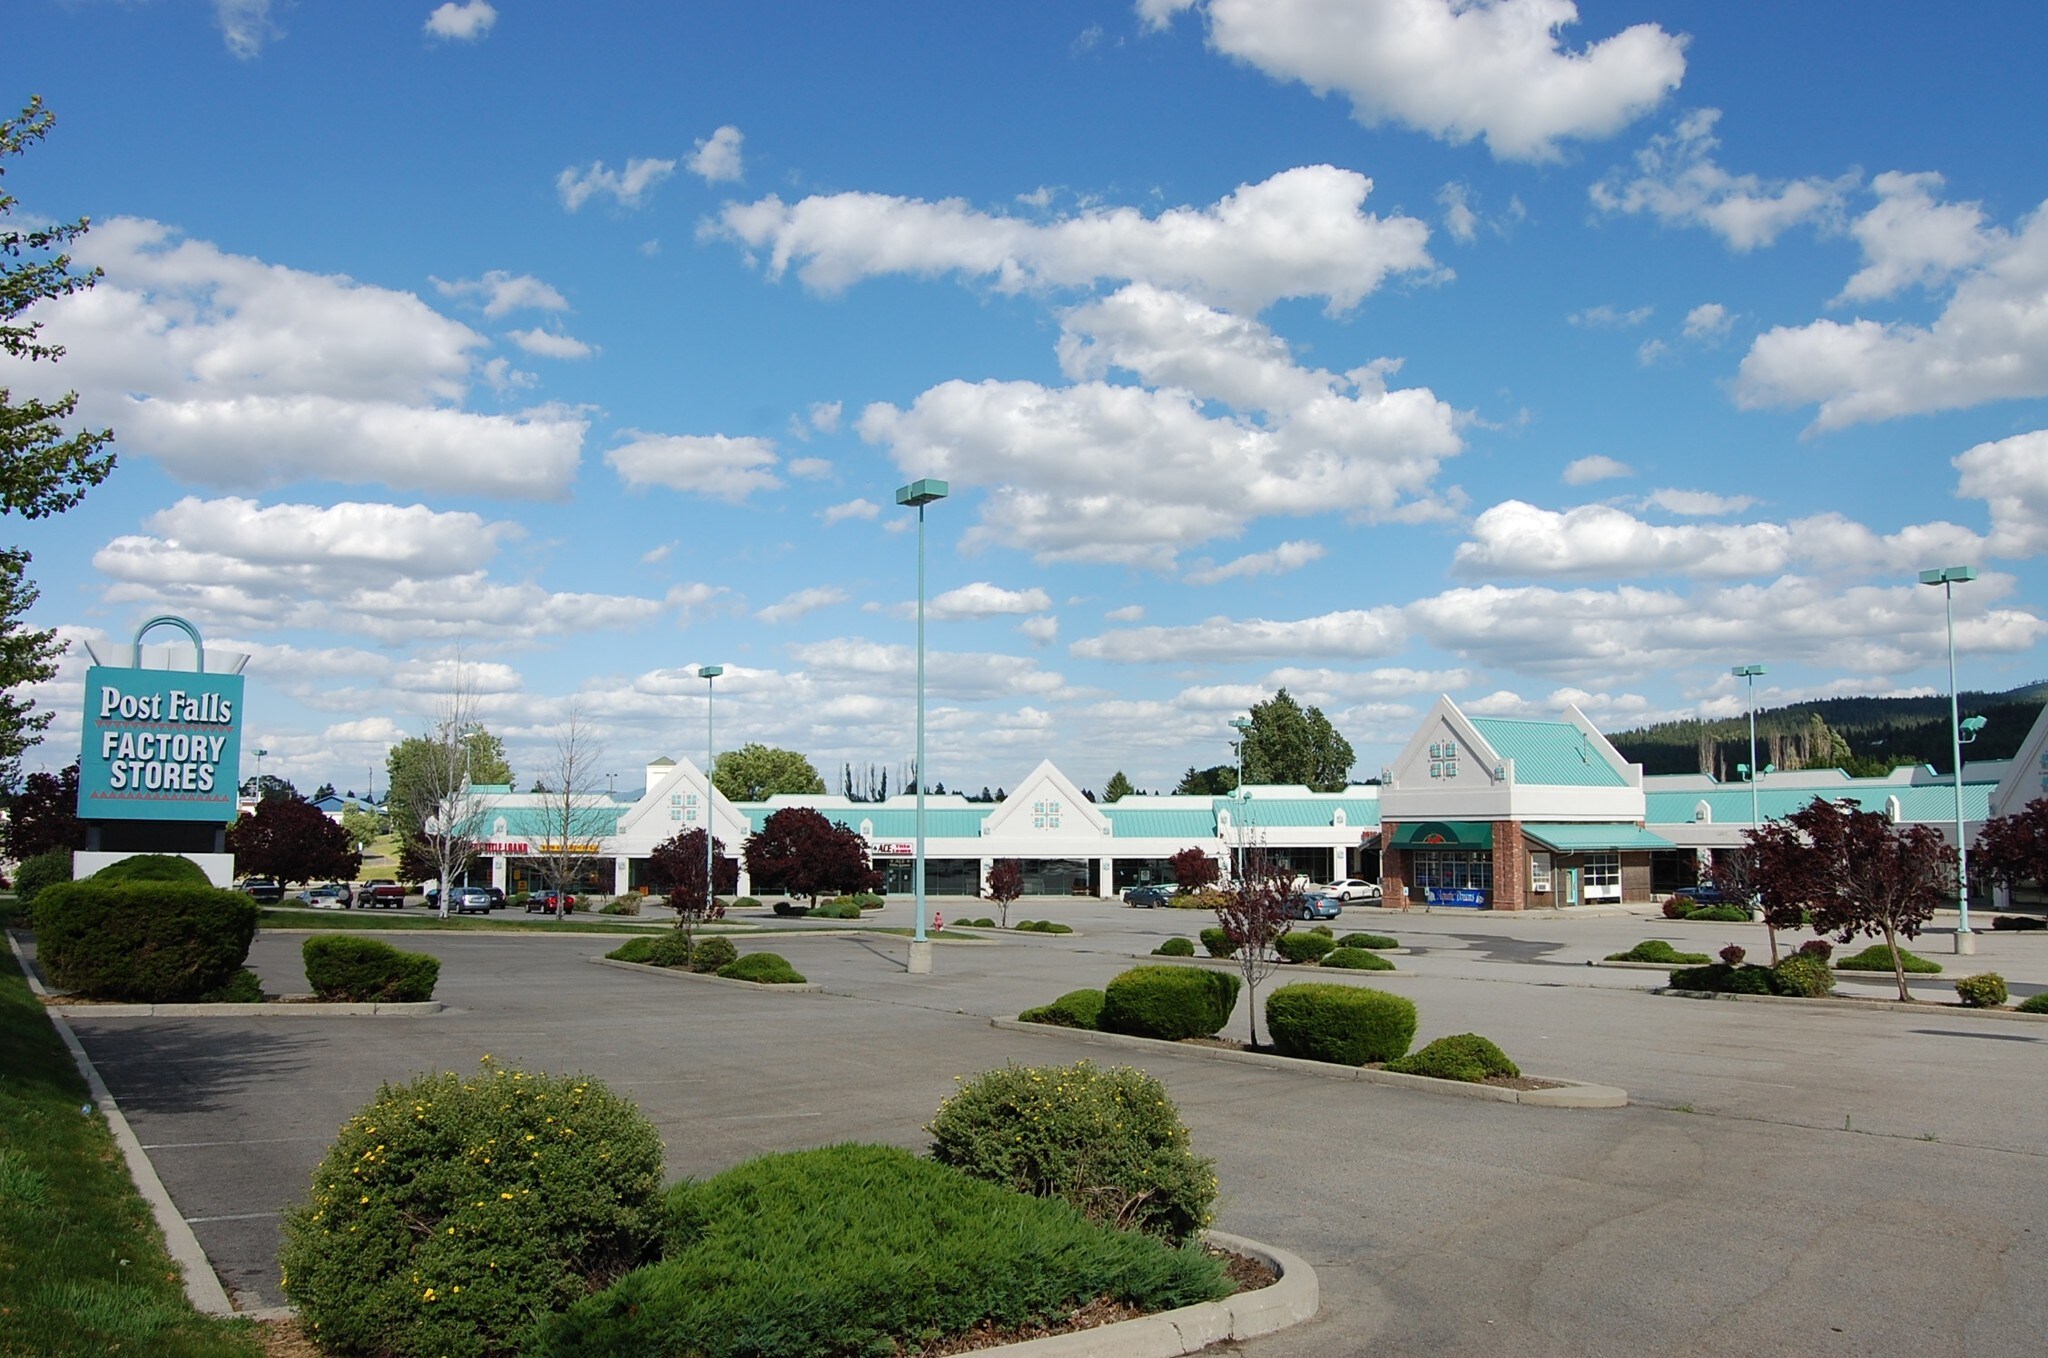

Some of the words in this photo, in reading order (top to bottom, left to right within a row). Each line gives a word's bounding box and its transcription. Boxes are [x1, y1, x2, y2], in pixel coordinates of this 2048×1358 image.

[100, 686, 161, 720] Post
[168, 690, 232, 723] Falls
[102, 731, 226, 762] FACTORY
[110, 760, 215, 791] STORES
[878, 844, 891, 853] ACE
